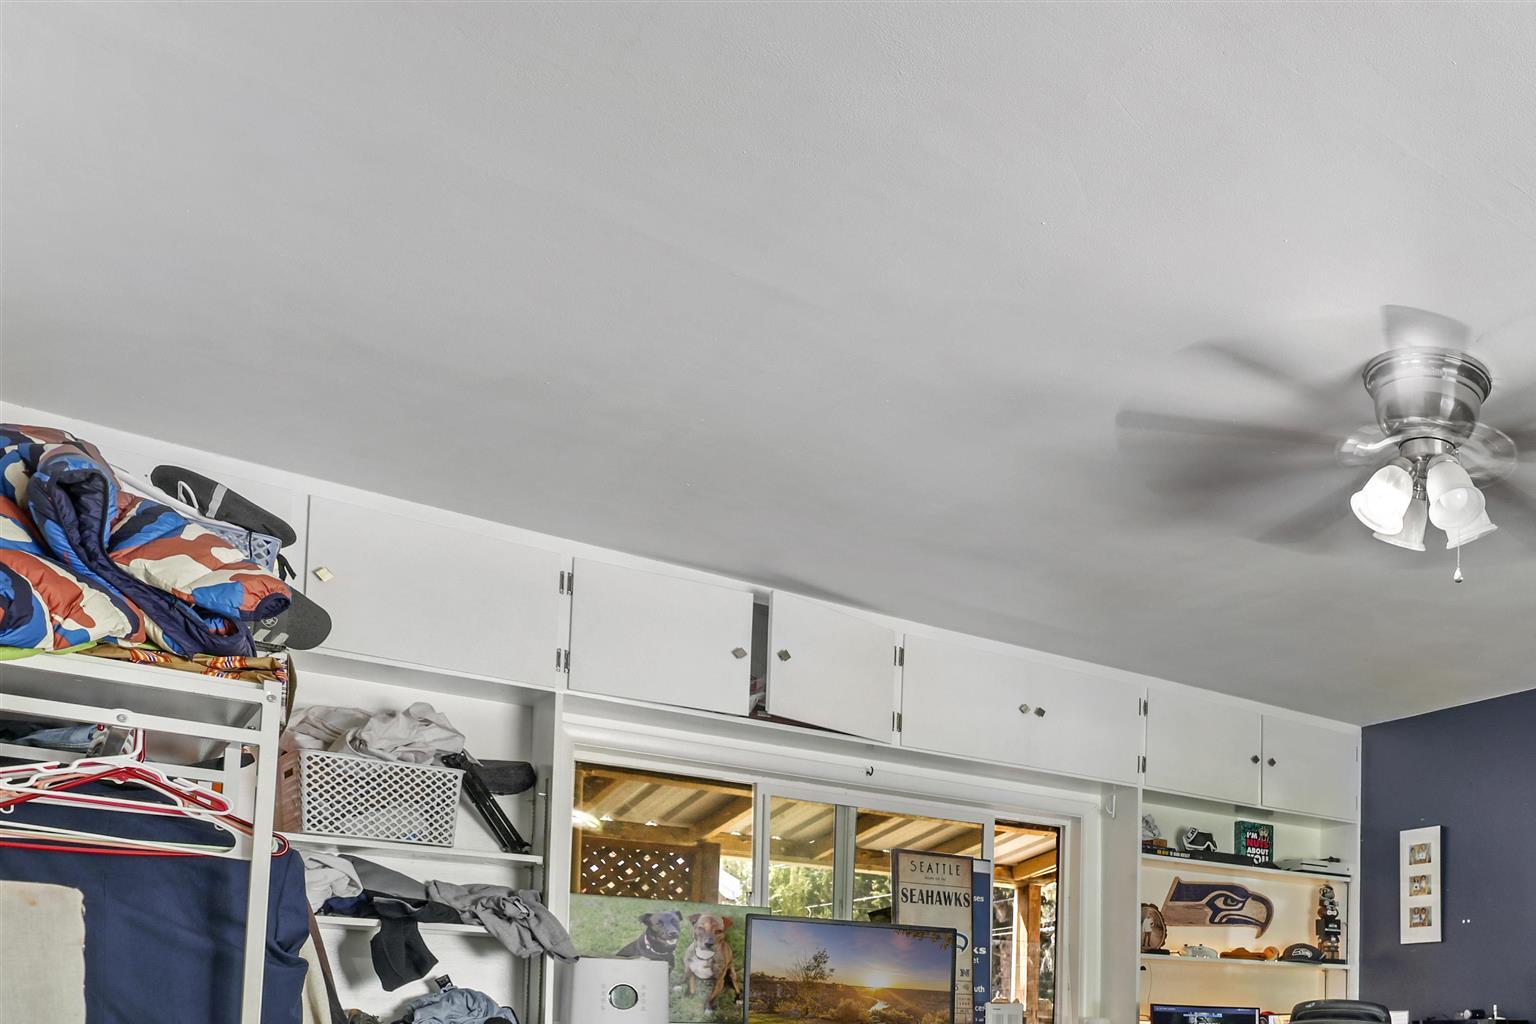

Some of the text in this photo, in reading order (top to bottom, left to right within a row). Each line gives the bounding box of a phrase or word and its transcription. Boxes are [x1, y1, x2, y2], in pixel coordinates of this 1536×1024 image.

[1247, 839, 1269, 848] NUTS
[1246, 847, 1269, 855] ABOUT
[910, 860, 960, 876] SEATTLE
[900, 887, 970, 908] SEAHAWKS
